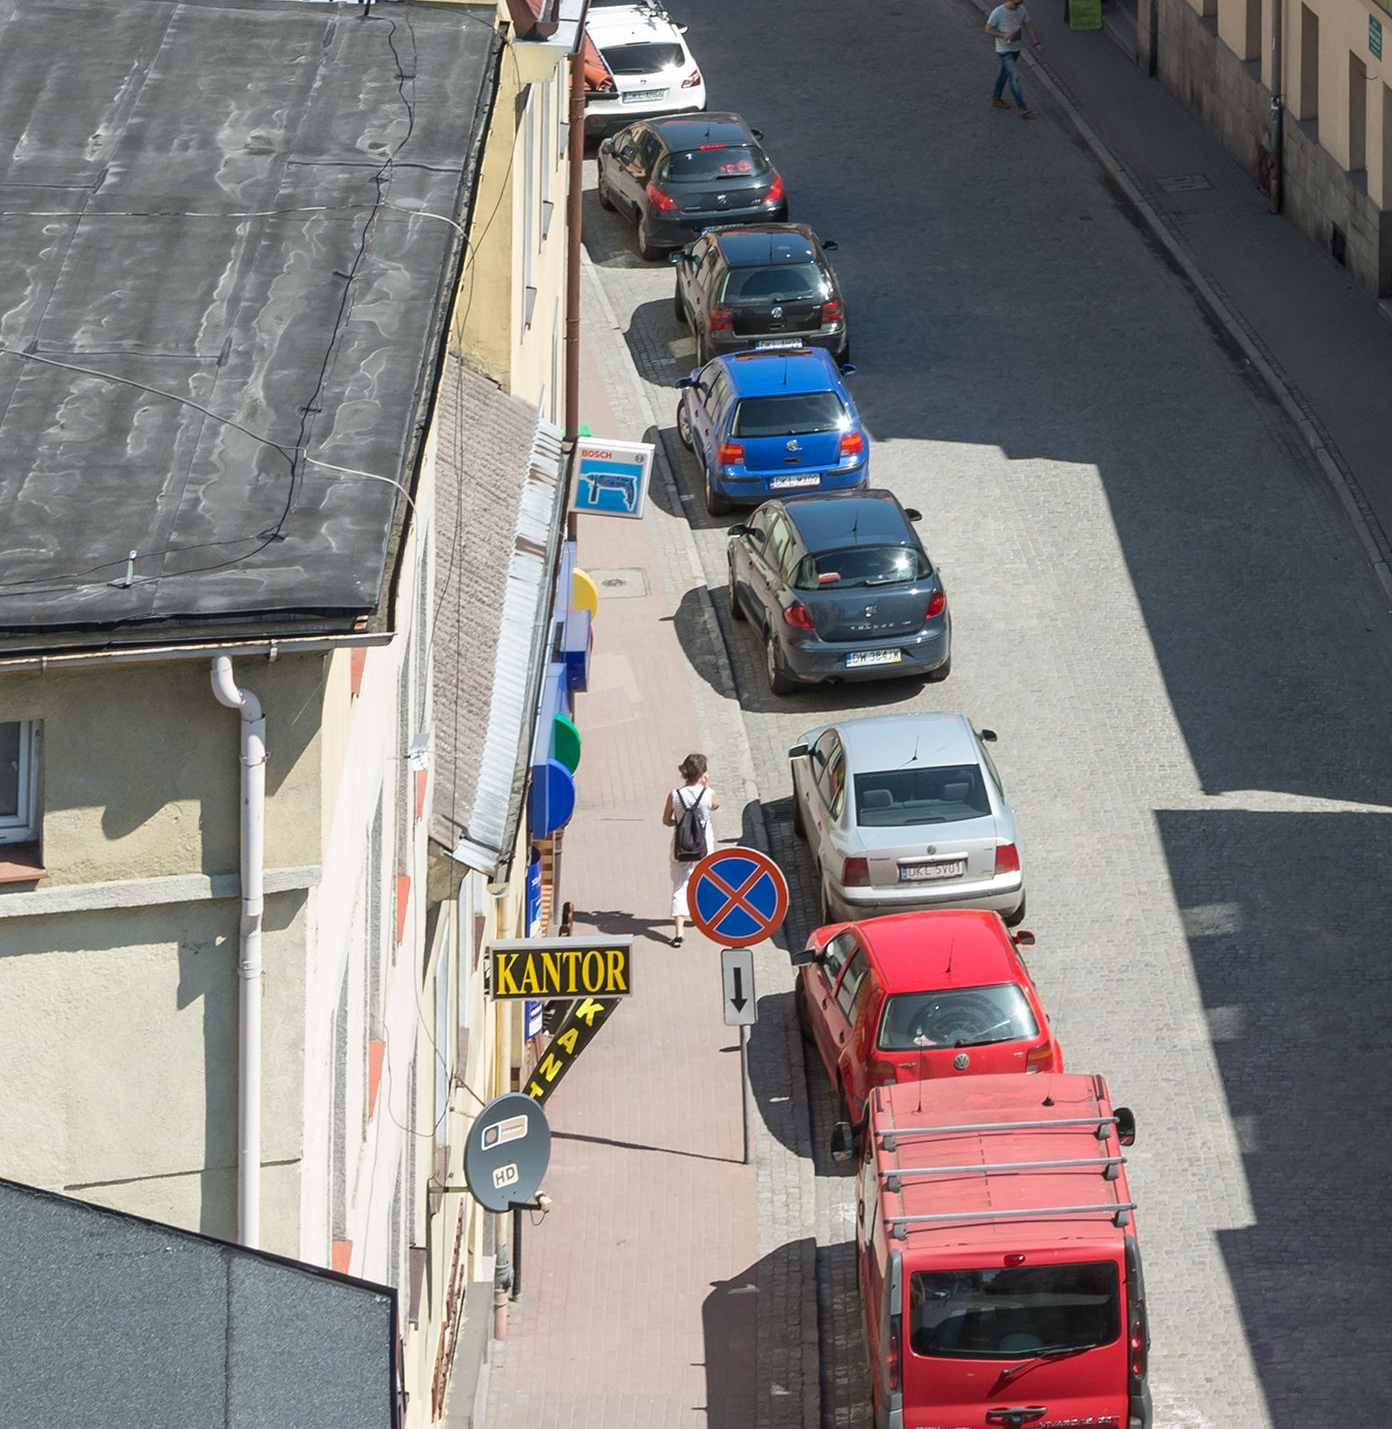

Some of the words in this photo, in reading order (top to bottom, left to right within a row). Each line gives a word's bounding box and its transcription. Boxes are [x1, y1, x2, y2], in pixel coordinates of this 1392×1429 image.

[581, 449, 613, 459] BOSCH
[775, 475, 794, 487] DKL
[852, 652, 867, 665] DW
[907, 863, 932, 877] DKL
[496, 950, 628, 995] KANTOR
[495, 1166, 516, 1186] HD
